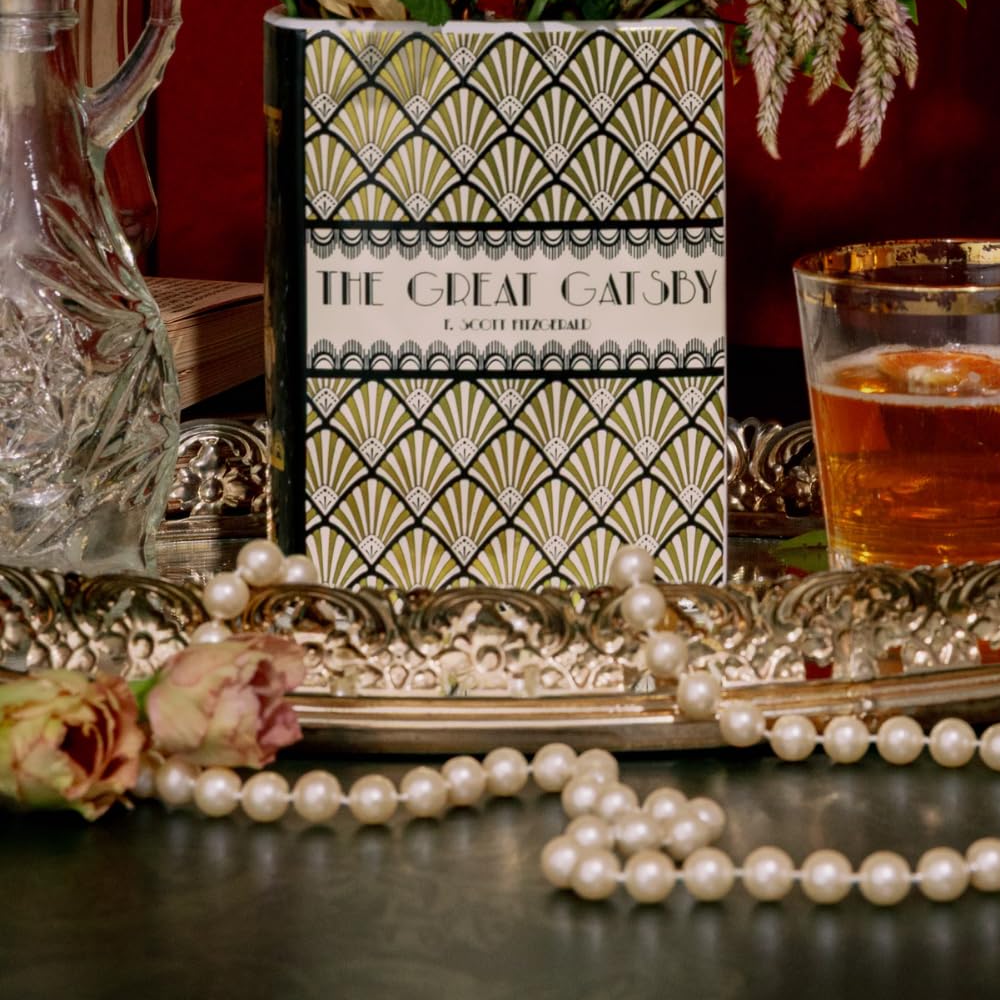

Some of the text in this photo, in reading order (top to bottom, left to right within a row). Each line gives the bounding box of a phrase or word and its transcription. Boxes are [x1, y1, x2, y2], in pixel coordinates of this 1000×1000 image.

[316, 269, 718, 307] THE GREAT GATSBY
[460, 318, 506, 331] SCOTT
[512, 318, 592, 332] FITZGERALD
